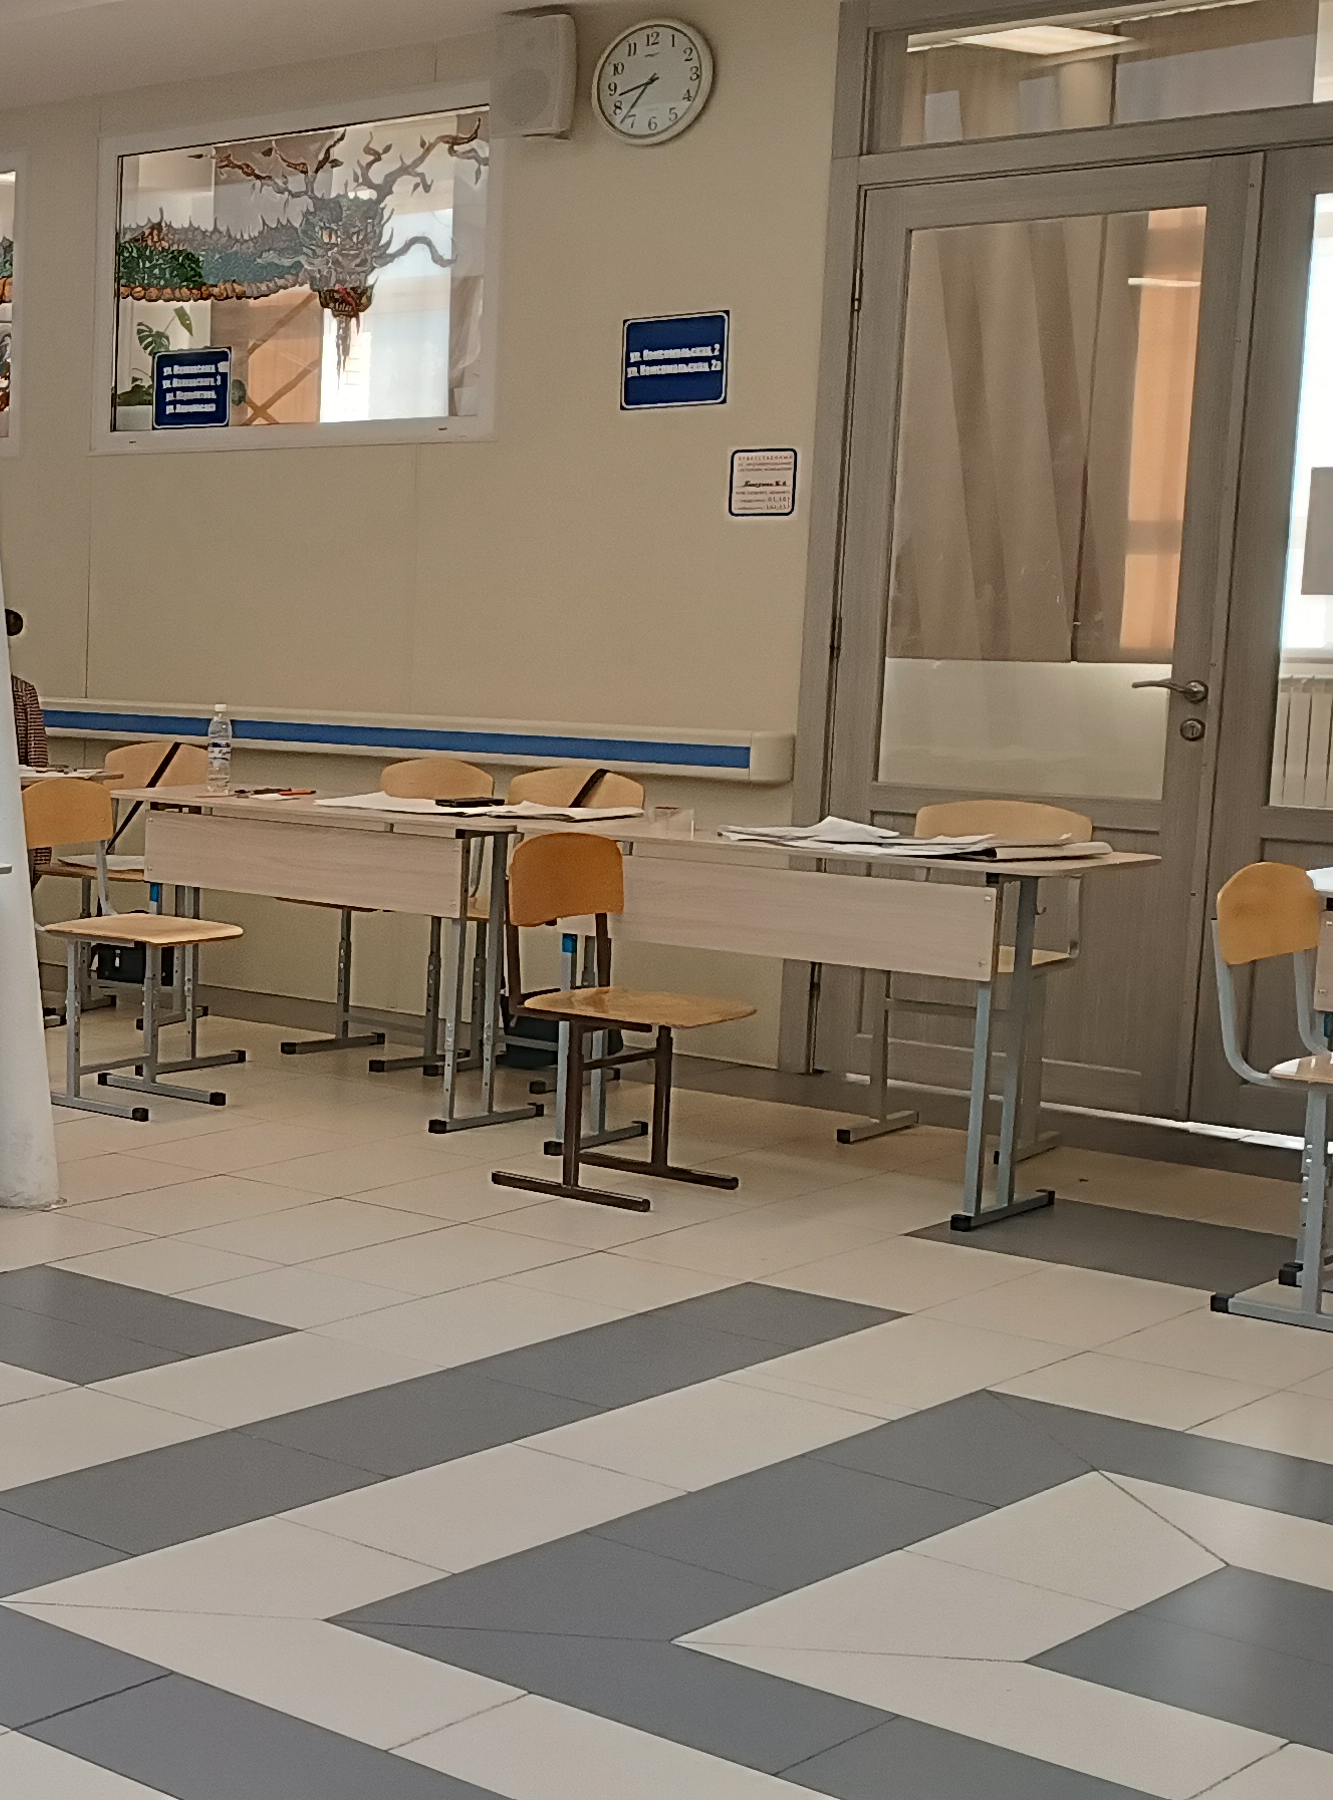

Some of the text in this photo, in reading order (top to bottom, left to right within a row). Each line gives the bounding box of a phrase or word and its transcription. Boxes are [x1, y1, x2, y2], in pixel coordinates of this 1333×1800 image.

[646, 31, 660, 46] 12
[627, 42, 637, 57] 11
[683, 47, 693, 62] 2
[613, 62, 625, 76] 10
[689, 65, 700, 82] 3
[607, 81, 618, 97] 9
[682, 88, 693, 102] 4
[613, 100, 623, 116] 8
[668, 107, 678, 122] 5
[627, 113, 637, 129] 7
[648, 116, 658, 131] 6
